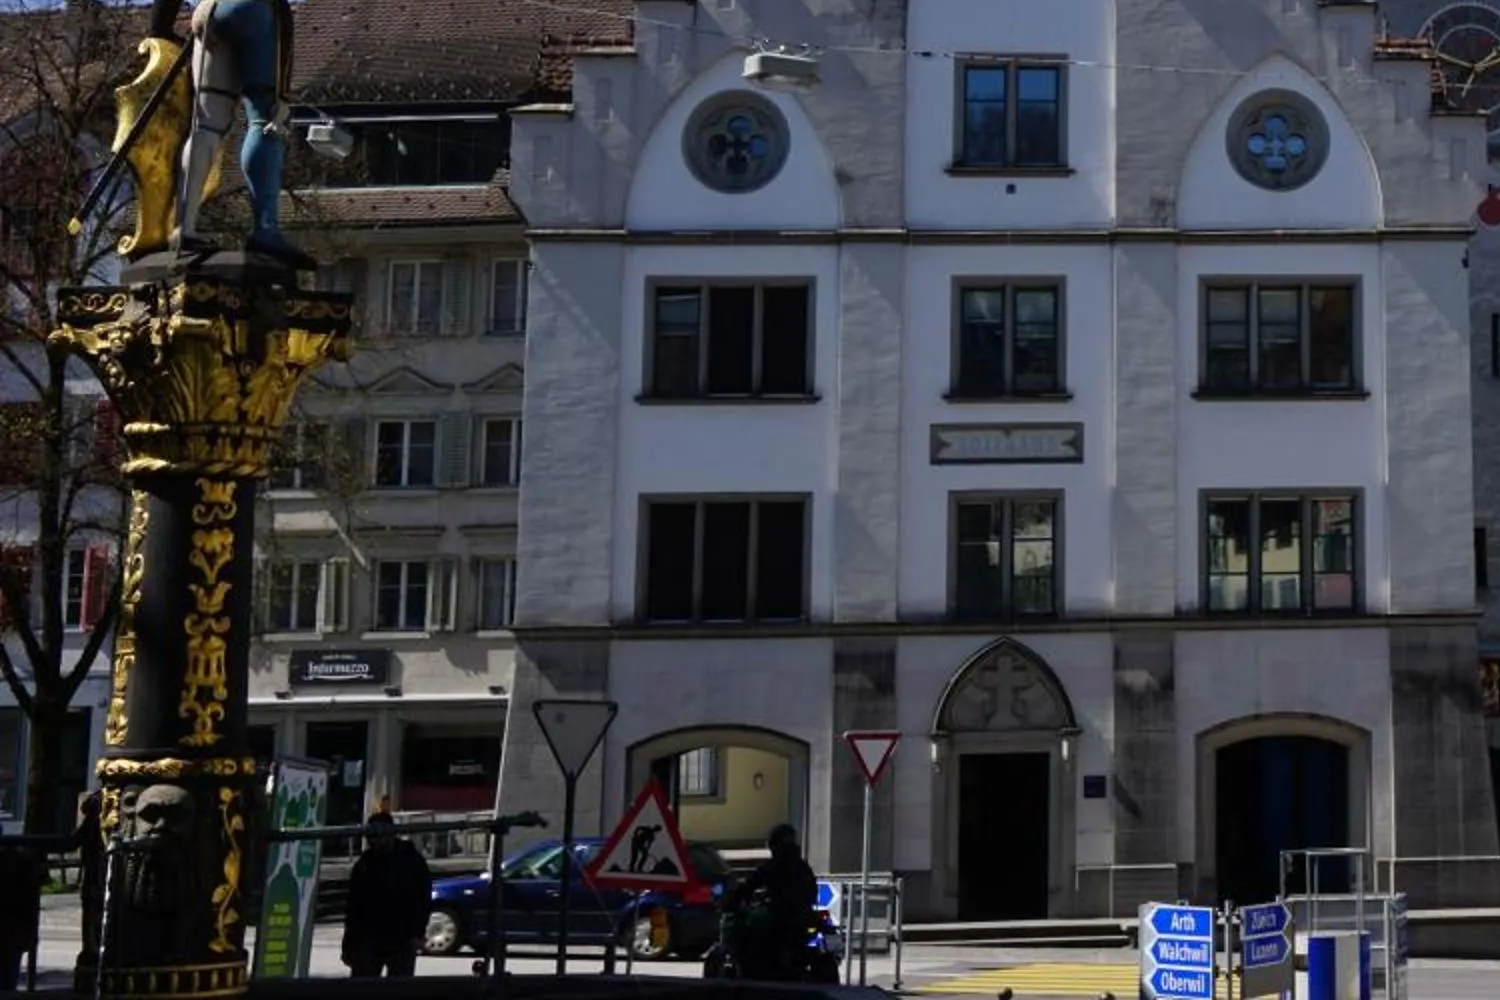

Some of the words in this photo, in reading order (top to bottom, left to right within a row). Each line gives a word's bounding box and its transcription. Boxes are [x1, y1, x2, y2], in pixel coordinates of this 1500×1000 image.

[1170, 913, 1196, 932] Arth
[1159, 942, 1209, 962] Walchwil
[1160, 972, 1205, 993] Oberwil
